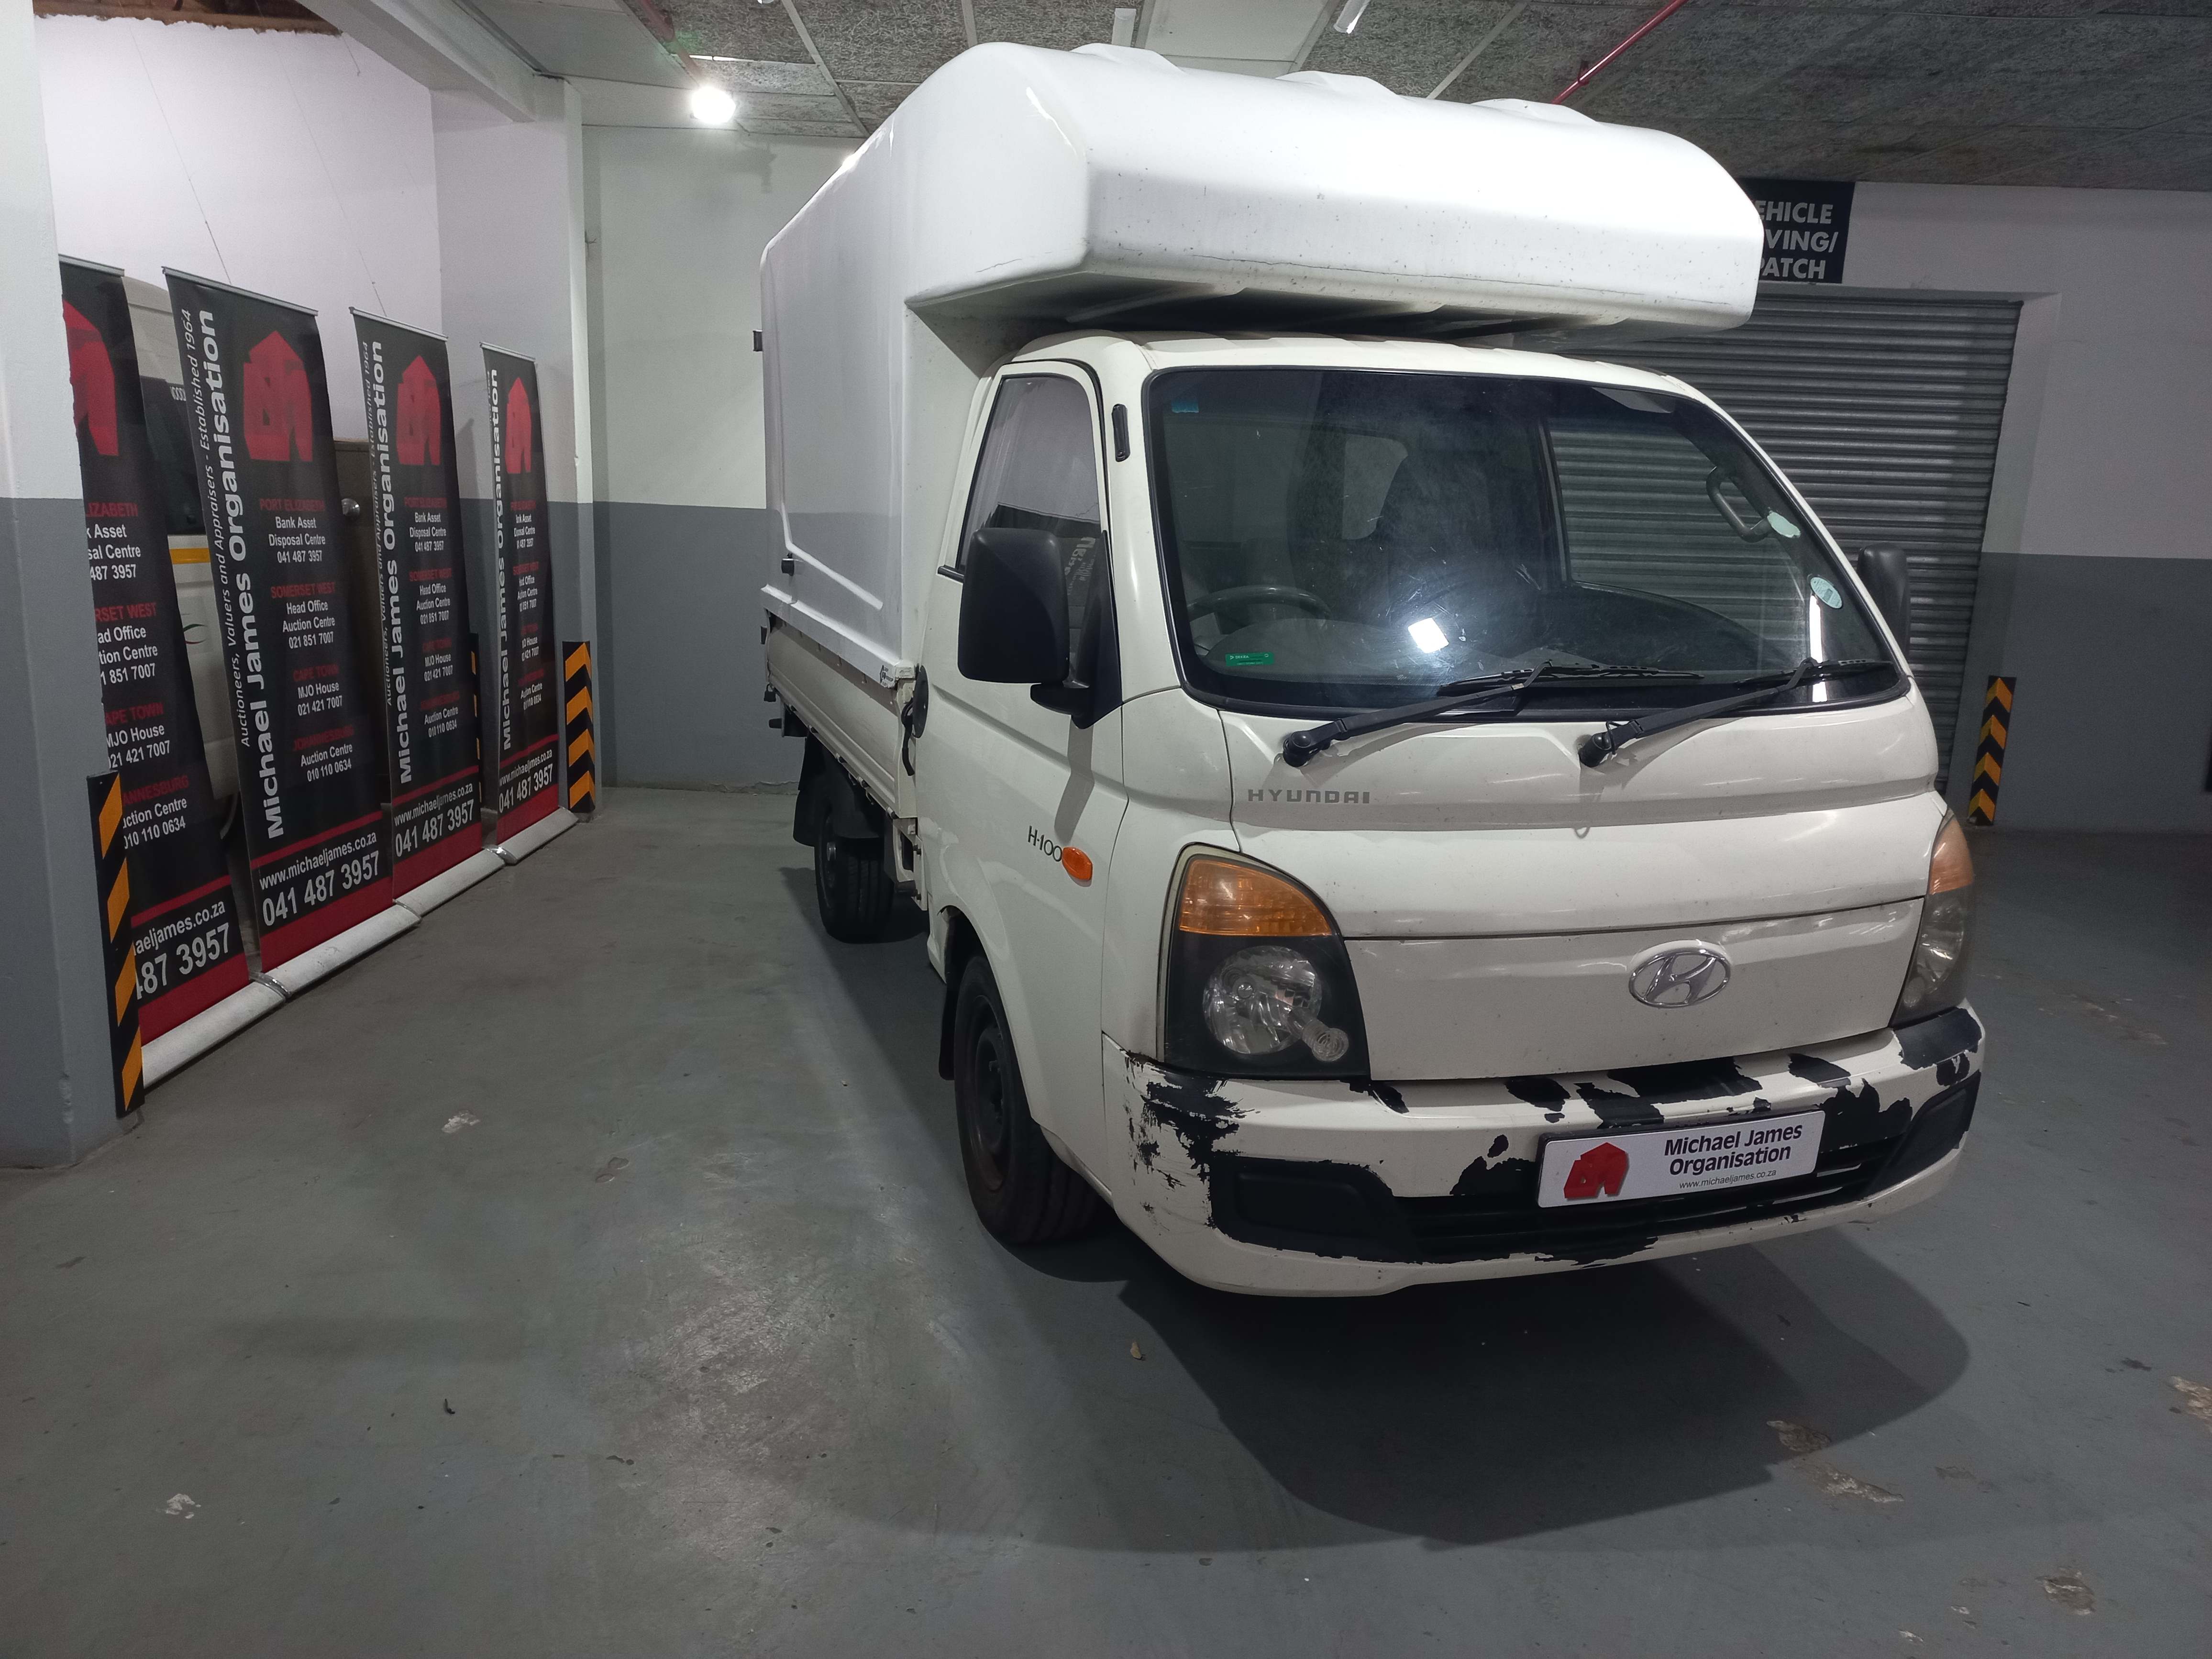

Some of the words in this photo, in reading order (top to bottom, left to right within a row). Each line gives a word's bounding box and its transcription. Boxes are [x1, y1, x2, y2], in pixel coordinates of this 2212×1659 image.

[181, 309, 196, 350] 1964
[187, 354, 210, 451] Established
[205, 465, 225, 550] Appraisers
[427, 512, 441, 522] Asset
[94, 524, 127, 538] Asset
[275, 516, 296, 528] Bank
[298, 517, 317, 528] Asset
[268, 533, 303, 549] Disposal
[305, 533, 326, 545] Centre
[409, 527, 431, 540] Disposal
[431, 526, 447, 537] Centre
[105, 544, 141, 559] Centre
[277, 551, 290, 563] 041
[292, 551, 306, 562] 487
[308, 550, 322, 562] 3957
[90, 565, 108, 580] 487
[111, 564, 136, 579] 3957
[215, 553, 228, 585] and
[420, 584, 431, 596] Head
[431, 583, 446, 594] Office
[498, 557, 508, 642] James
[127, 602, 156, 619] WEST
[287, 601, 306, 614] Head
[308, 600, 329, 612] Office
[387, 559, 403, 659] James
[435, 597, 450, 608] Centre
[222, 588, 236, 646] Valuers
[283, 618, 312, 633] Auction
[313, 616, 335, 629] Centre
[98, 628, 111, 643] ad
[113, 625, 146, 641] Office
[236, 573, 264, 690] James
[288, 636, 301, 649] 021
[303, 634, 317, 646] 851
[319, 631, 334, 644] 7007
[99, 650, 121, 664] tion
[123, 644, 158, 661] Centre
[435, 653, 451, 664] House
[109, 667, 129, 684] 851
[131, 663, 155, 680] 7007
[383, 627, 392, 706] Auctioneers,
[232, 653, 250, 747] Auctioneers,
[297, 685, 314, 699] MJO
[316, 682, 339, 695] House
[501, 649, 511, 750] Michael
[129, 702, 164, 720] TOWN
[298, 702, 310, 716] 021
[311, 699, 324, 712] 421
[327, 695, 343, 709] 7007
[443, 706, 458, 719] Centre
[130, 724, 165, 742] House
[392, 666, 412, 785] Michael
[126, 747, 144, 763] 421
[146, 740, 170, 758] 7007
[300, 751, 328, 767] Auction
[330, 743, 353, 757] Centre
[250, 700, 284, 839] Michael
[307, 768, 320, 782] 010
[321, 764, 333, 777] 110
[335, 758, 352, 773] 0634
[499, 786, 513, 813] 041
[517, 776, 531, 801] 487
[534, 763, 553, 791] 3957
[1248, 789, 1370, 804] HYUNDAI
[155, 797, 188, 818] Centre
[141, 824, 160, 842] 110
[162, 815, 186, 836] 0634
[396, 825, 418, 857] 041
[422, 813, 443, 842] 487
[447, 798, 474, 831] 3957
[1028, 825, 1062, 862] H-100
[259, 832, 377, 890] www.michaeljames.co.za
[263, 887, 297, 926] 041
[304, 869, 335, 906] 487
[341, 850, 379, 889] 3957
[176, 922, 229, 975] 3957
[1664, 1131, 1741, 1156] Michael
[1744, 1125, 1803, 1147] James
[1670, 1145, 1791, 1175] Organisation
[1679, 1169, 1776, 1189] www.michaeljames.co.za
